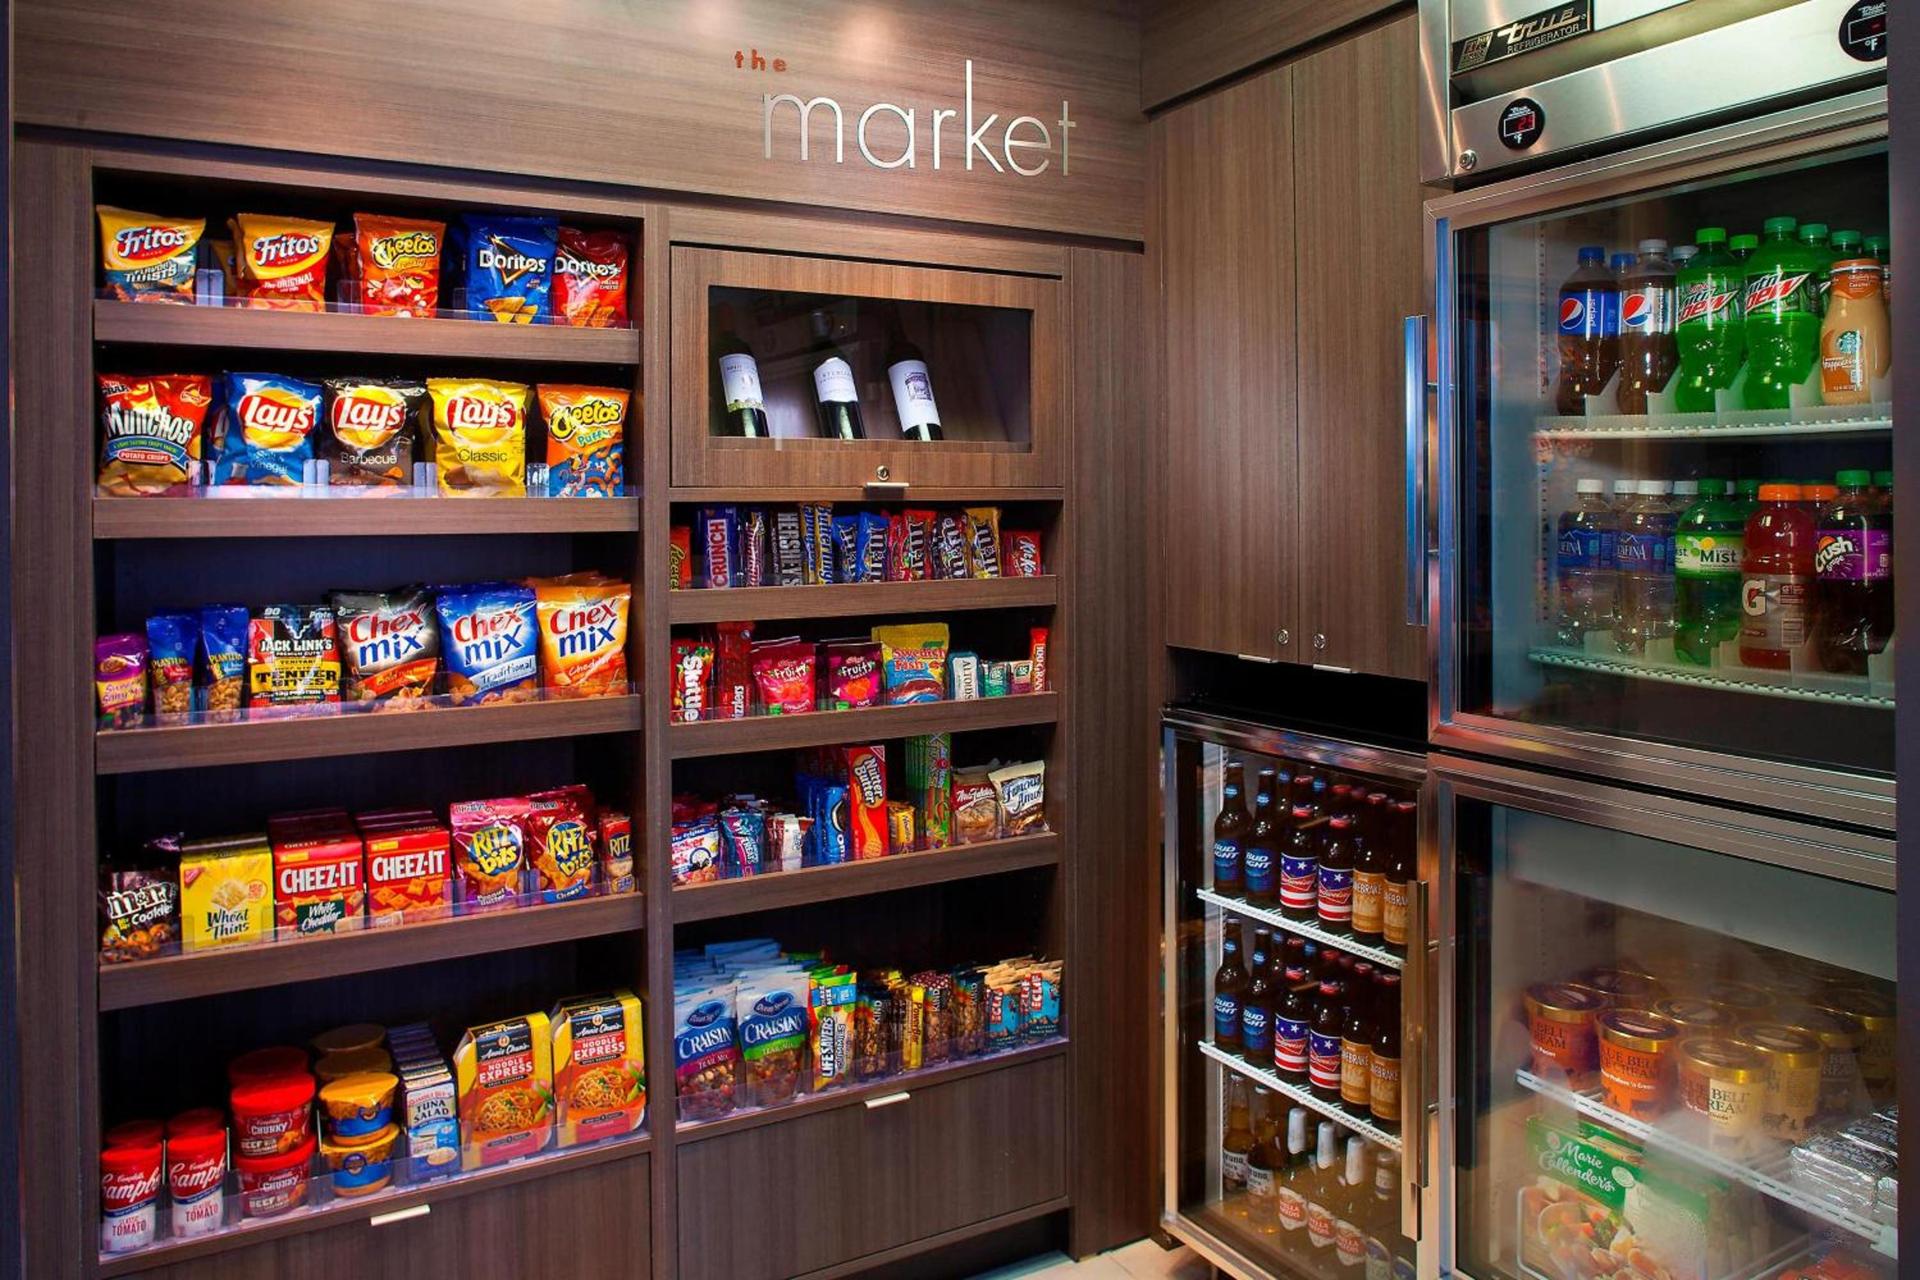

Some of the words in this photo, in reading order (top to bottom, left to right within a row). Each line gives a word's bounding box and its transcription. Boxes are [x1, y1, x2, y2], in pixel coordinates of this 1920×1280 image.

[1507, 24, 1579, 54] REFRIGERATOR
[734, 49, 788, 72] the
[763, 59, 1076, 177] market
[116, 226, 186, 258] Fritos
[253, 234, 319, 266] Fritos
[372, 233, 437, 268] Cheetos
[479, 249, 547, 272] Doritos
[554, 256, 621, 277] Doritos
[103, 400, 194, 445] Munchos
[120, 452, 145, 460] POTATO
[340, 452, 398, 465] Barbecue
[458, 448, 508, 463] Classic
[709, 520, 729, 587] CRUNCH
[778, 512, 804, 586] HERSHEY'S
[1700, 549, 1737, 564] Mist
[1815, 536, 1854, 573] Crush
[1826, 555, 1845, 572] grape
[1742, 579, 1766, 617] G
[350, 601, 428, 644] Chex
[453, 603, 525, 644] Chex
[549, 599, 618, 634] Chex
[261, 639, 291, 652] JACK
[294, 638, 333, 652] LINK'S
[359, 627, 425, 669] mix
[464, 619, 525, 667] mix
[558, 619, 617, 657] mix
[892, 648, 946, 658] Swedish
[255, 670, 337, 683] TENDER
[481, 661, 533, 685] Traditional
[773, 663, 807, 679] Fruity
[840, 661, 873, 677] Fruity
[894, 661, 924, 671] Fish
[961, 660, 974, 700] ALTOIDS
[854, 765, 875, 806] Butter
[863, 756, 883, 799] Nutter
[1004, 776, 1042, 803] Famous
[470, 824, 512, 858] RITZ
[546, 825, 588, 857] RITZ
[609, 832, 631, 857] RITZ
[372, 850, 445, 882] CHEEZ-IT
[478, 845, 518, 874] bits
[559, 850, 592, 876] bits
[281, 861, 358, 895] CHEEZ-IT
[205, 921, 250, 940] Thins
[207, 908, 249, 930] Wheat
[932, 988, 940, 1012] KIND
[970, 982, 978, 1005] KIND
[872, 1000, 883, 1025] KIND
[574, 1041, 626, 1061] EXPRESS
[582, 1037, 618, 1049] NOODLE
[821, 1017, 834, 1077] LIFESAVERS
[480, 1062, 533, 1083] EXPRESS
[488, 1057, 524, 1072] NOODLE
[414, 1107, 449, 1123] SALAD
[416, 1099, 446, 1113] TUNA
[251, 1121, 289, 1135] CHUNKY
[1561, 1141, 1604, 1169] Marie
[262, 1176, 298, 1192] CHUNKY
[1539, 1151, 1616, 1193] Callender's
[185, 1205, 219, 1222] TOMATO
[112, 1219, 147, 1237] TOMATO
